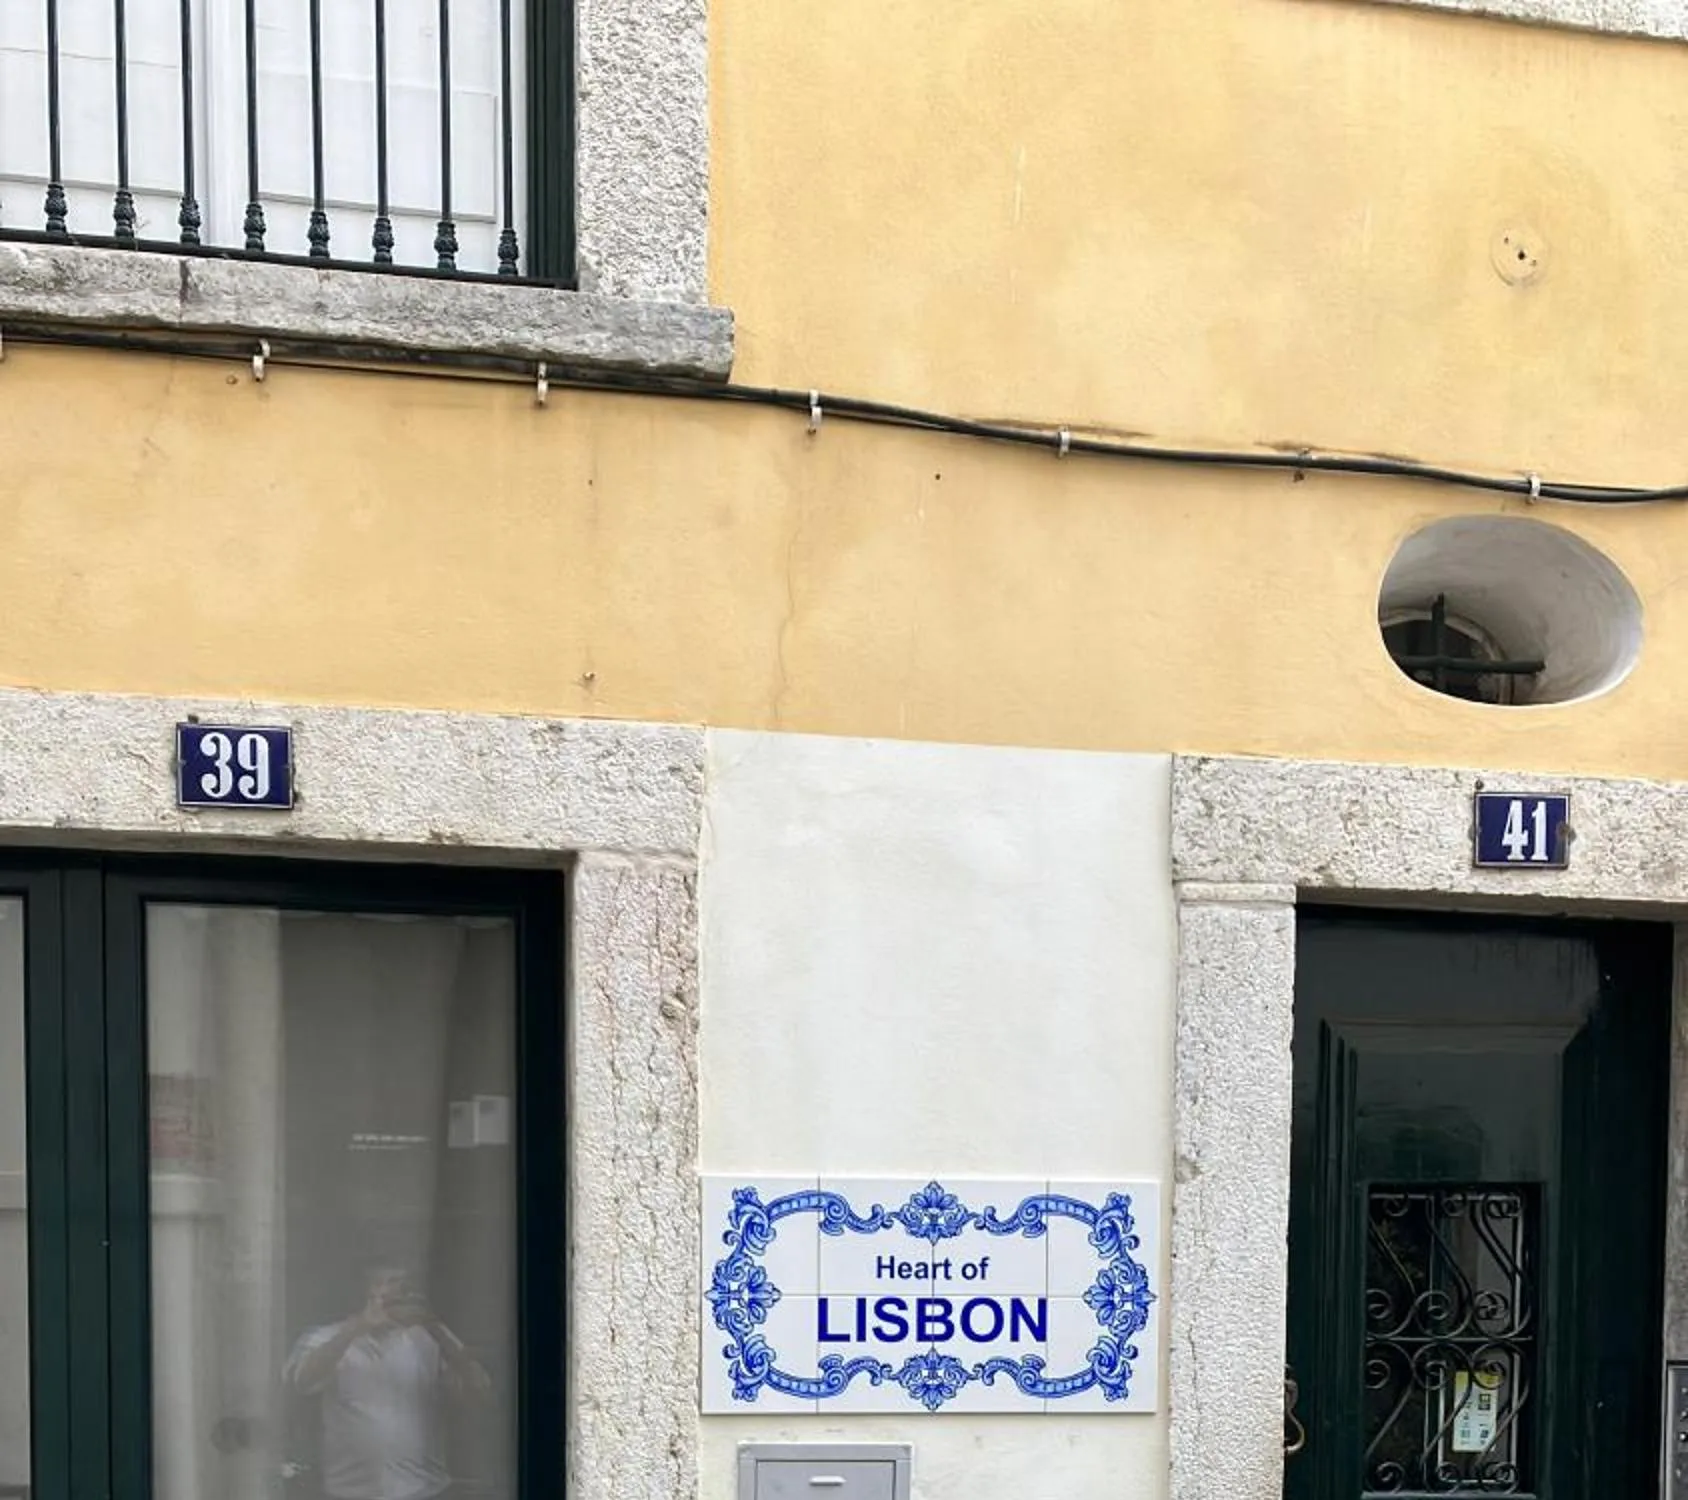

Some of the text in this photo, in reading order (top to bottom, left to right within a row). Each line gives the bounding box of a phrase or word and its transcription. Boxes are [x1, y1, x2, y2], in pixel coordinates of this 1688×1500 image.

[200, 732, 270, 800] 39
[1501, 799, 1548, 861] 41
[875, 1255, 990, 1281] Heart of
[817, 1297, 1047, 1343] LISBON
